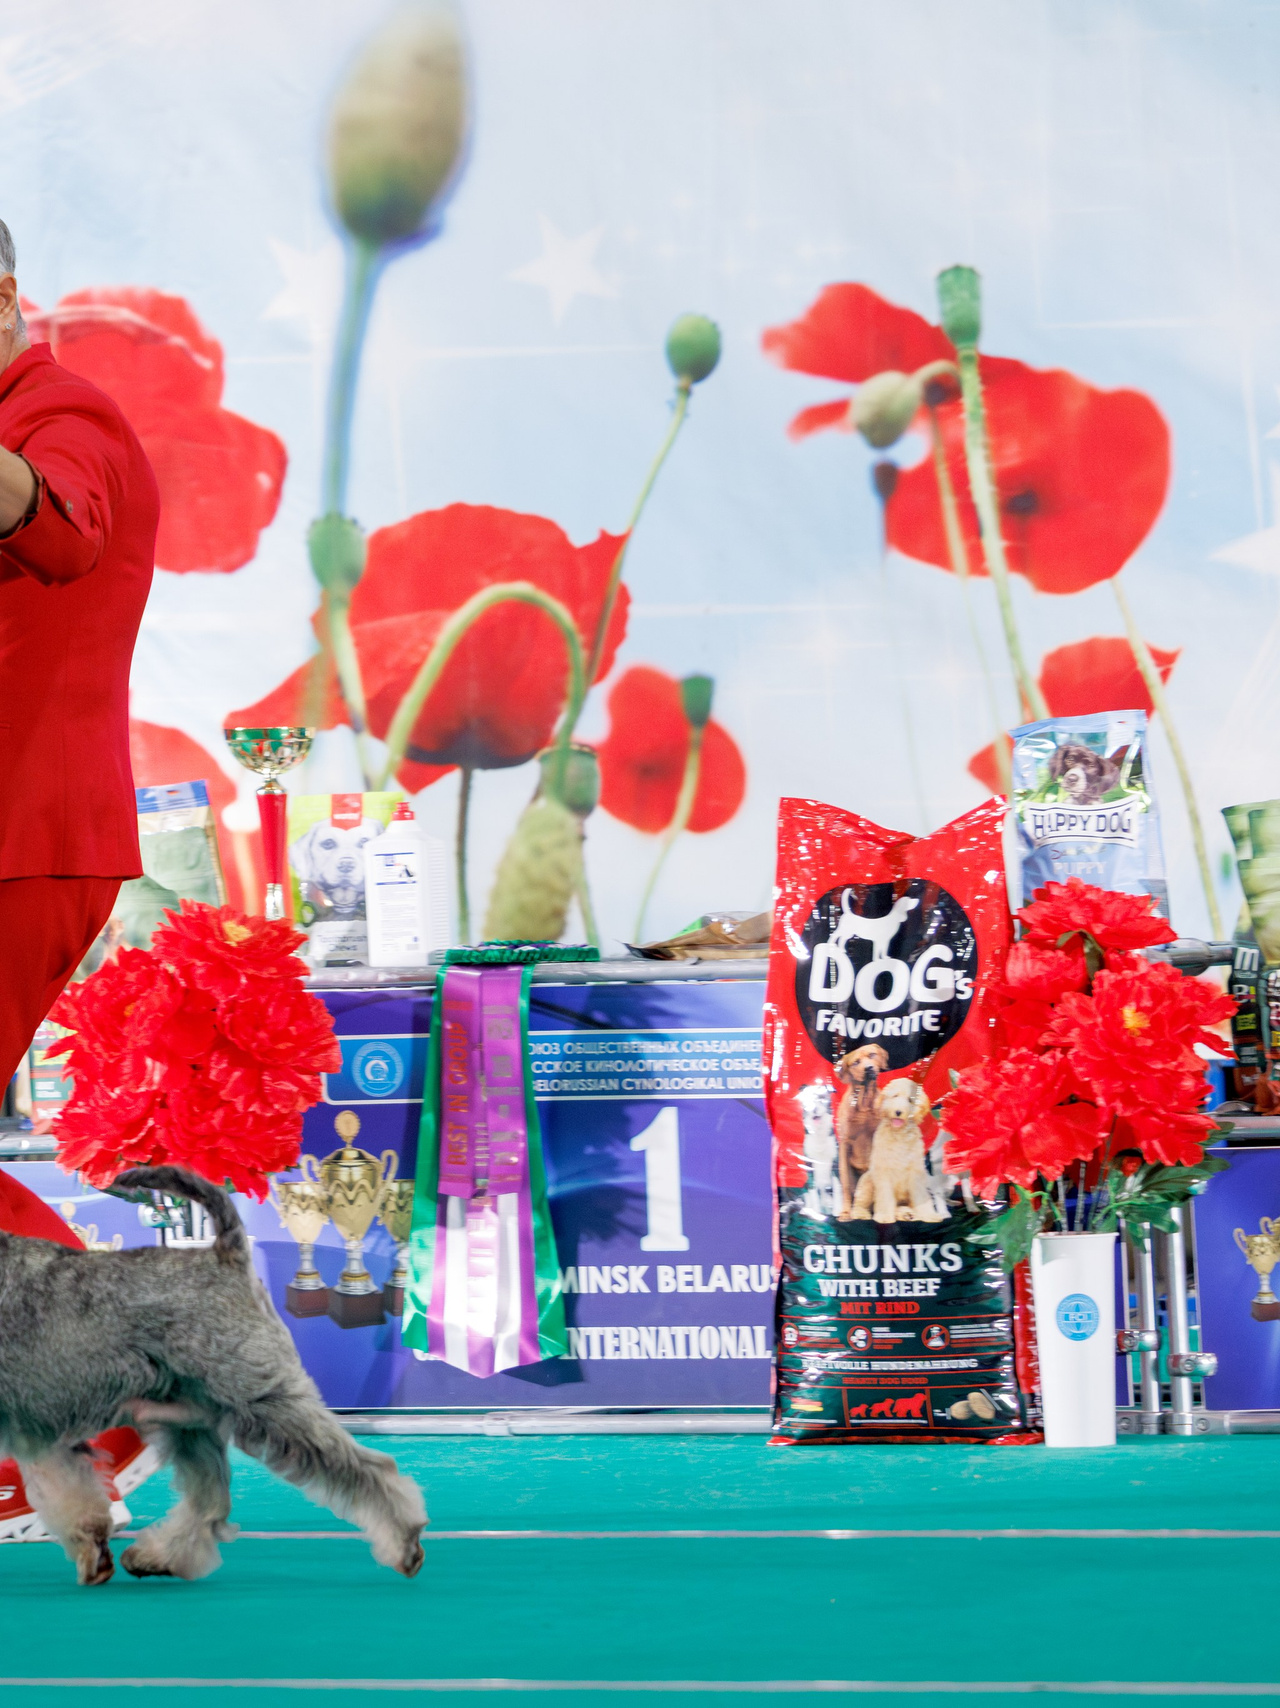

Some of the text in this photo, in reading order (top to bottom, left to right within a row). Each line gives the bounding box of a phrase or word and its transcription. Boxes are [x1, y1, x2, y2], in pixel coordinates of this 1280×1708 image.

[1095, 808, 1132, 833] DOG
[1053, 861, 1107, 875] PUPPY
[816, 1009, 942, 1040] FAVORITE
[529, 1042, 561, 1055] ОЮЗ
[563, 1041, 680, 1055] ОБЩЕСТВЕННЫХ
[531, 1060, 583, 1074] ССКОЕ
[585, 1058, 720, 1073] КИНОЛОГИЧЕСКОЕ
[446, 1021, 469, 1166] BEST IN GROUP
[621, 1076, 725, 1091] CYNOLOGIKAL
[726, 1076, 763, 1090] UNIO
[630, 1106, 690, 1252] 1
[803, 1243, 963, 1274] CHUNKS
[817, 1278, 941, 1298] WITH BEEF
[840, 1301, 920, 1315] MIT RIND
